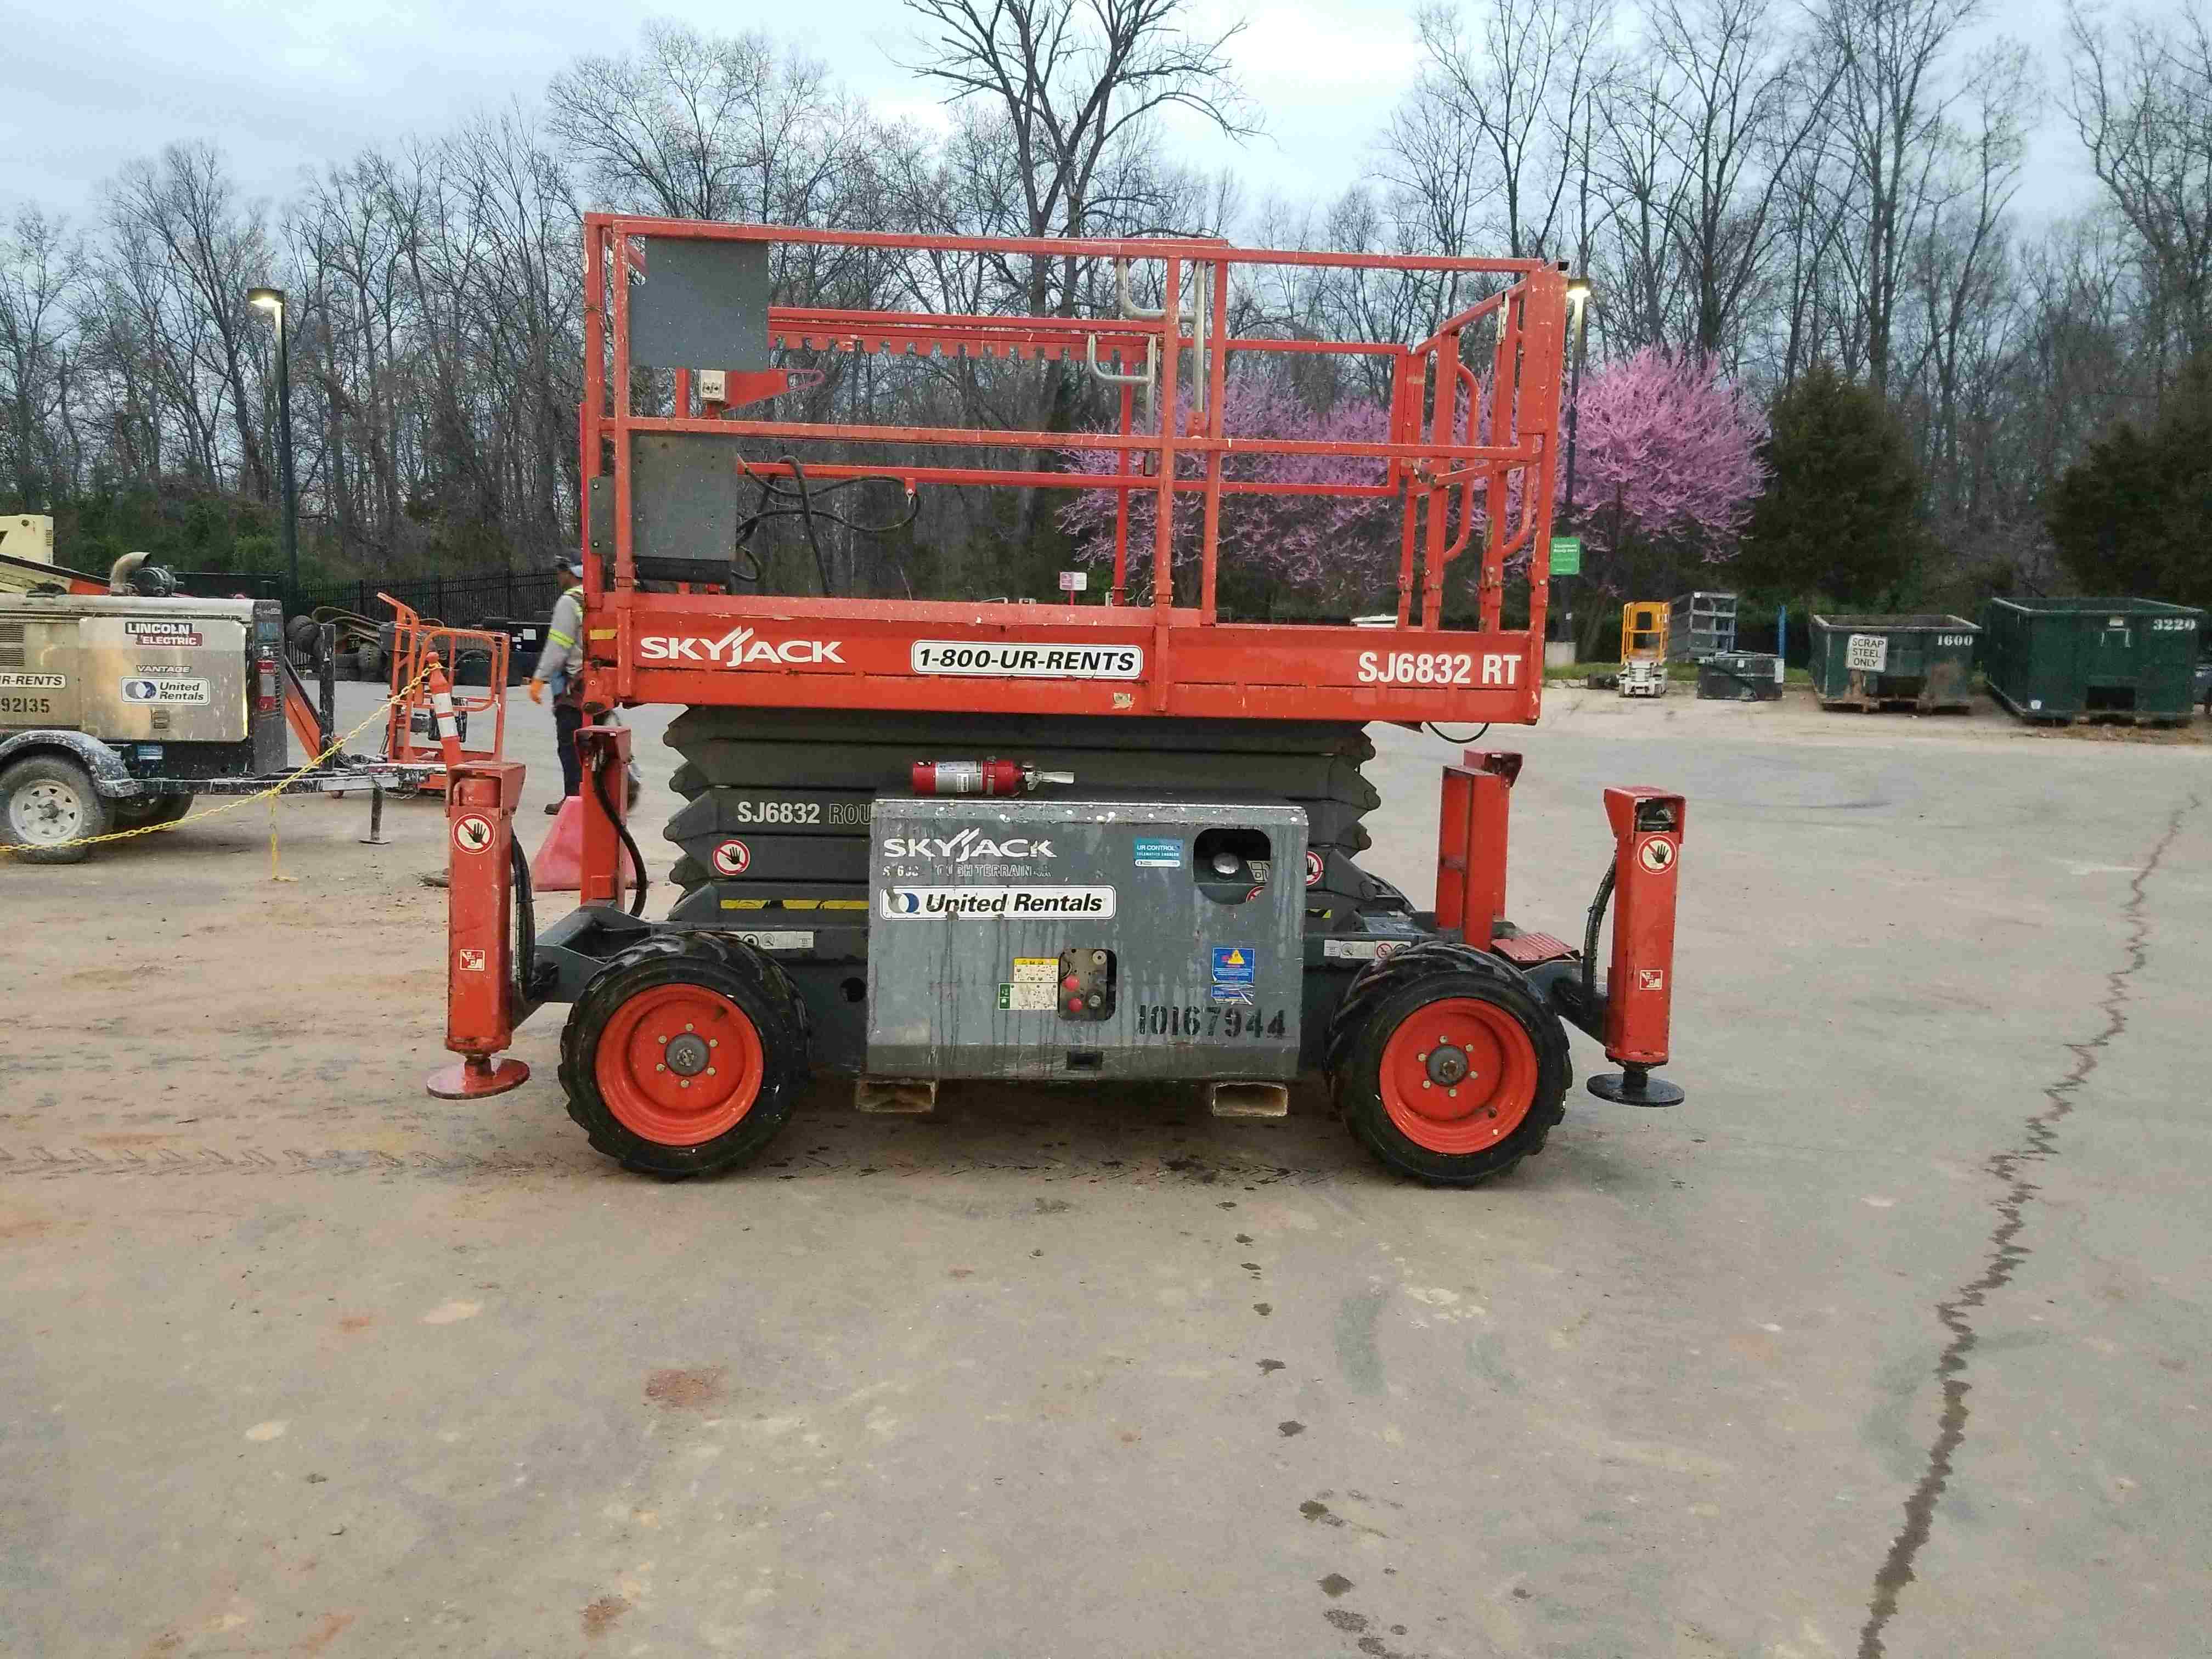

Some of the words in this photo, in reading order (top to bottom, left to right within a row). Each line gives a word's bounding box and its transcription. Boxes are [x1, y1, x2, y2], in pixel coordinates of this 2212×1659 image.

[127, 623, 190, 634] LINCOLN
[142, 636, 197, 645] ELECTRIC
[1852, 637, 1884, 648] SCRAP
[1937, 635, 1973, 646] 1600
[640, 625, 847, 668] SKYJACK
[1852, 648, 1881, 658] STEEL
[919, 648, 1135, 672] 1-800-UR-RENTS
[1853, 658, 1878, 667] ONLY
[1357, 651, 1471, 684] SJ6832
[1481, 654, 1522, 685] RT
[0, 675, 63, 686] R-RENTS
[159, 682, 201, 691] United
[159, 691, 205, 701] Rentals
[737, 800, 821, 823] SJ6832
[883, 827, 1058, 862] SKYJACK
[974, 864, 1032, 877] TERRAIN
[926, 893, 1008, 912] United
[1013, 893, 1103, 912] Rentals
[1138, 1005, 1285, 1040] 10167944
